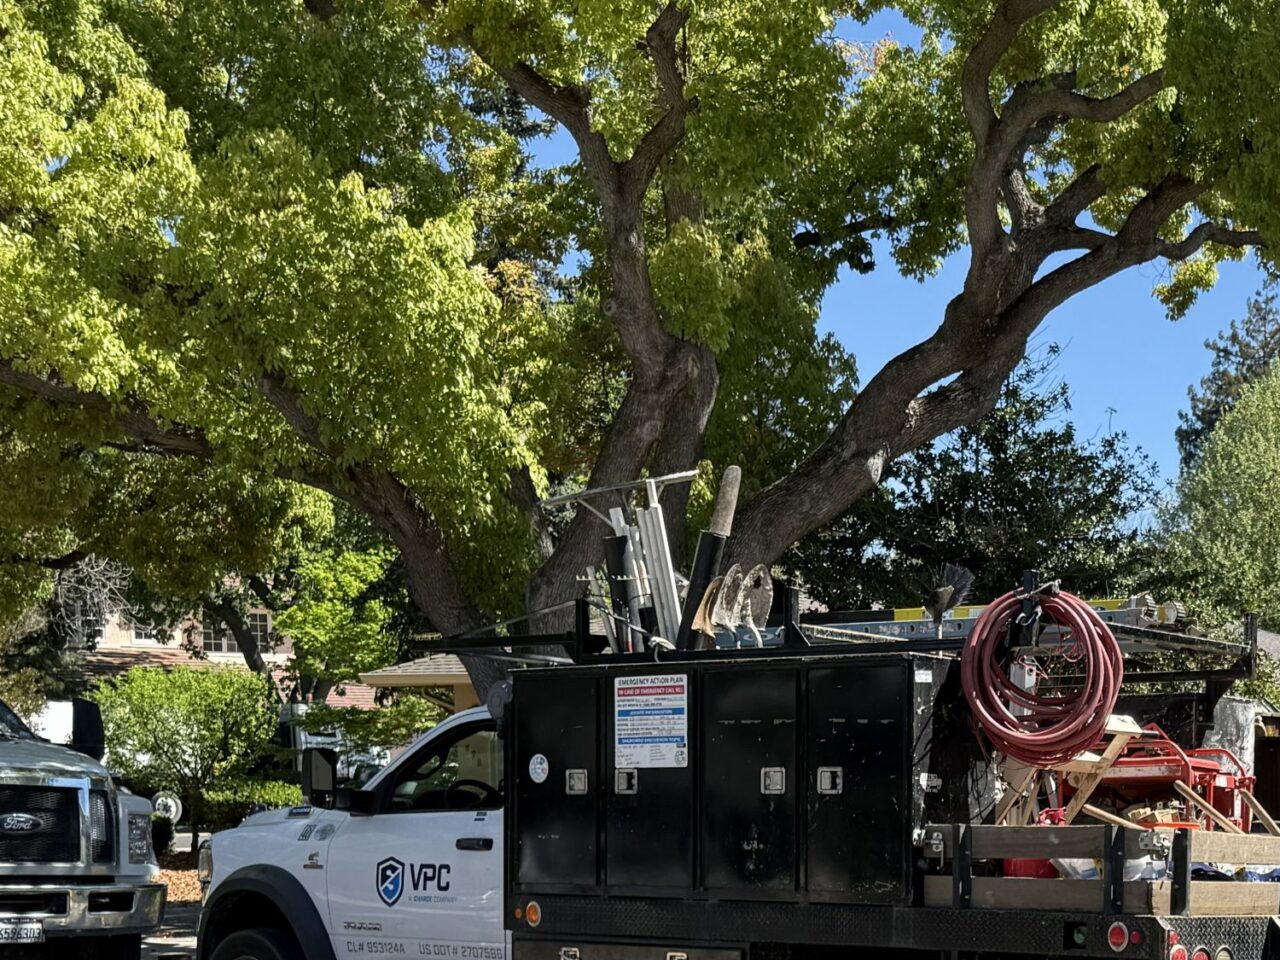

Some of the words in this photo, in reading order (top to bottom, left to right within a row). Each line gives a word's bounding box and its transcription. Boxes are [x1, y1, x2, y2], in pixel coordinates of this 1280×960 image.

[618, 678, 649, 686] EMERGENCY
[650, 677, 669, 685] ACTION
[3, 817, 33, 830] Ford
[410, 863, 451, 892] VPC
[346, 941, 364, 953] CL#
[367, 941, 406, 954] 953124A
[419, 943, 432, 955] US
